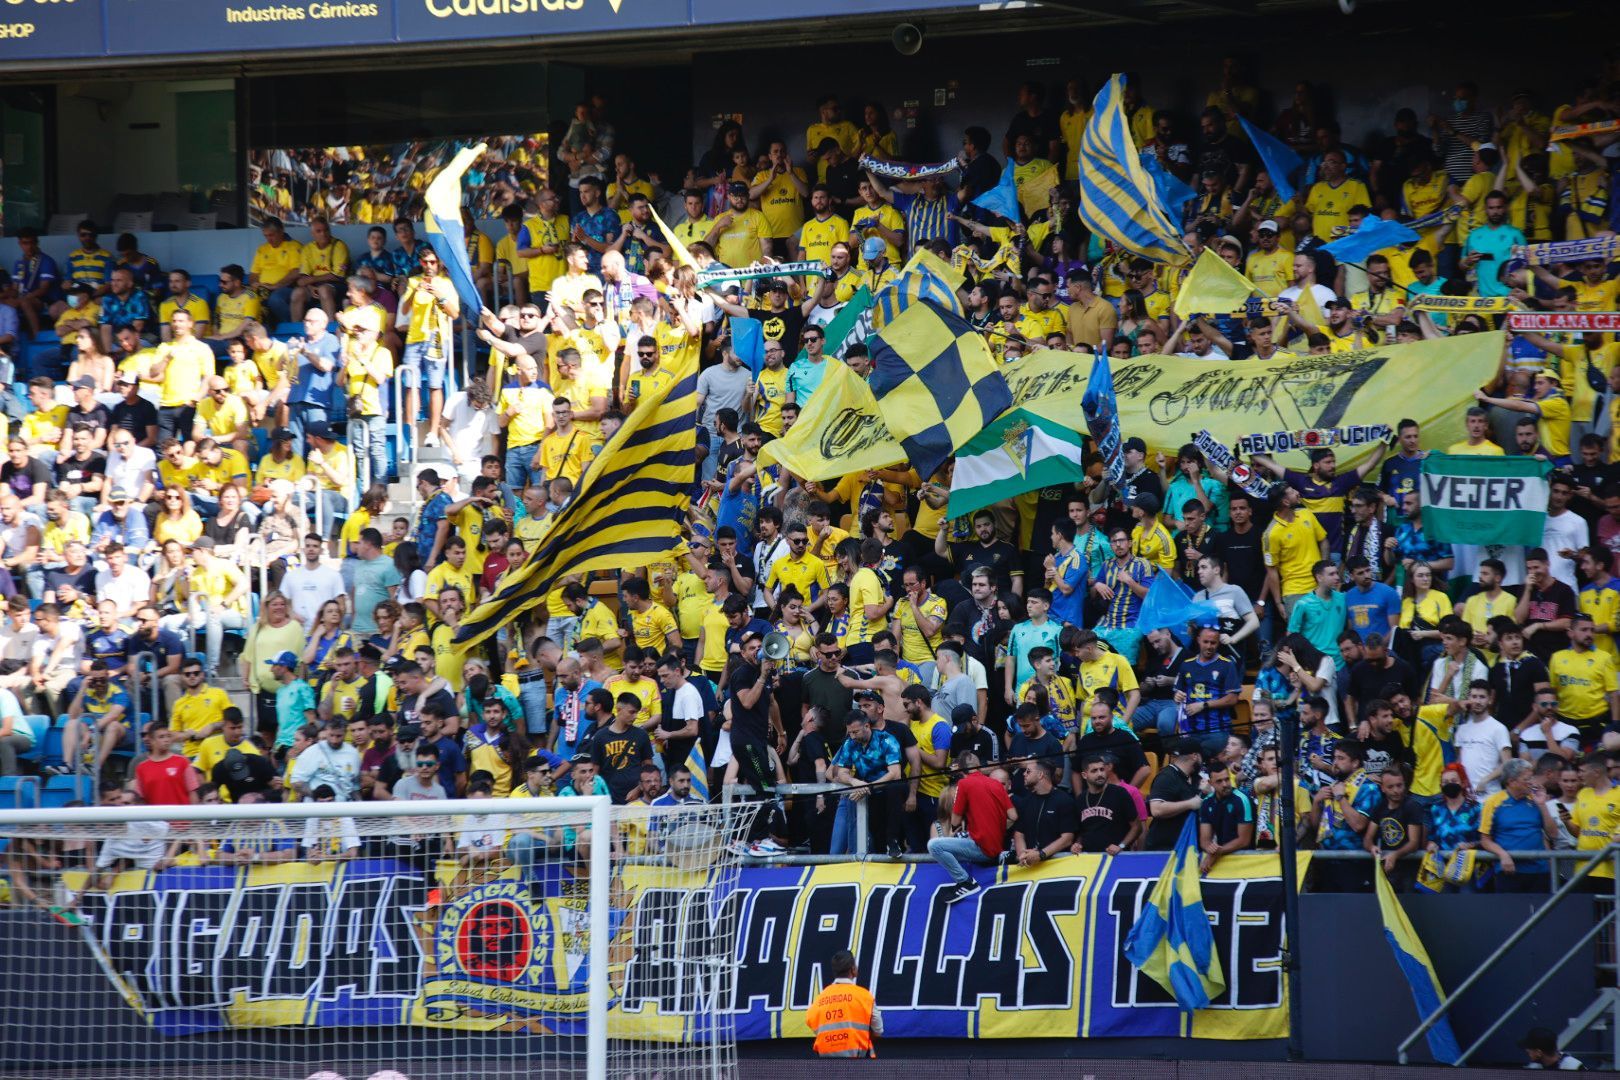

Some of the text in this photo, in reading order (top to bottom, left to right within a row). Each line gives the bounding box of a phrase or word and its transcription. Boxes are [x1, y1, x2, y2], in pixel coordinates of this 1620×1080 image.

[226, 1, 379, 23] Industrias Cárnicas
[1510, 314, 1590, 329] CHICLANA
[1424, 473, 1525, 510] VEJER
[622, 877, 1087, 1016] AMARILLAS
[818, 993, 853, 1007] SEGURIDAD
[825, 1008, 844, 1021] 073
[825, 1032, 849, 1043] SICOR
